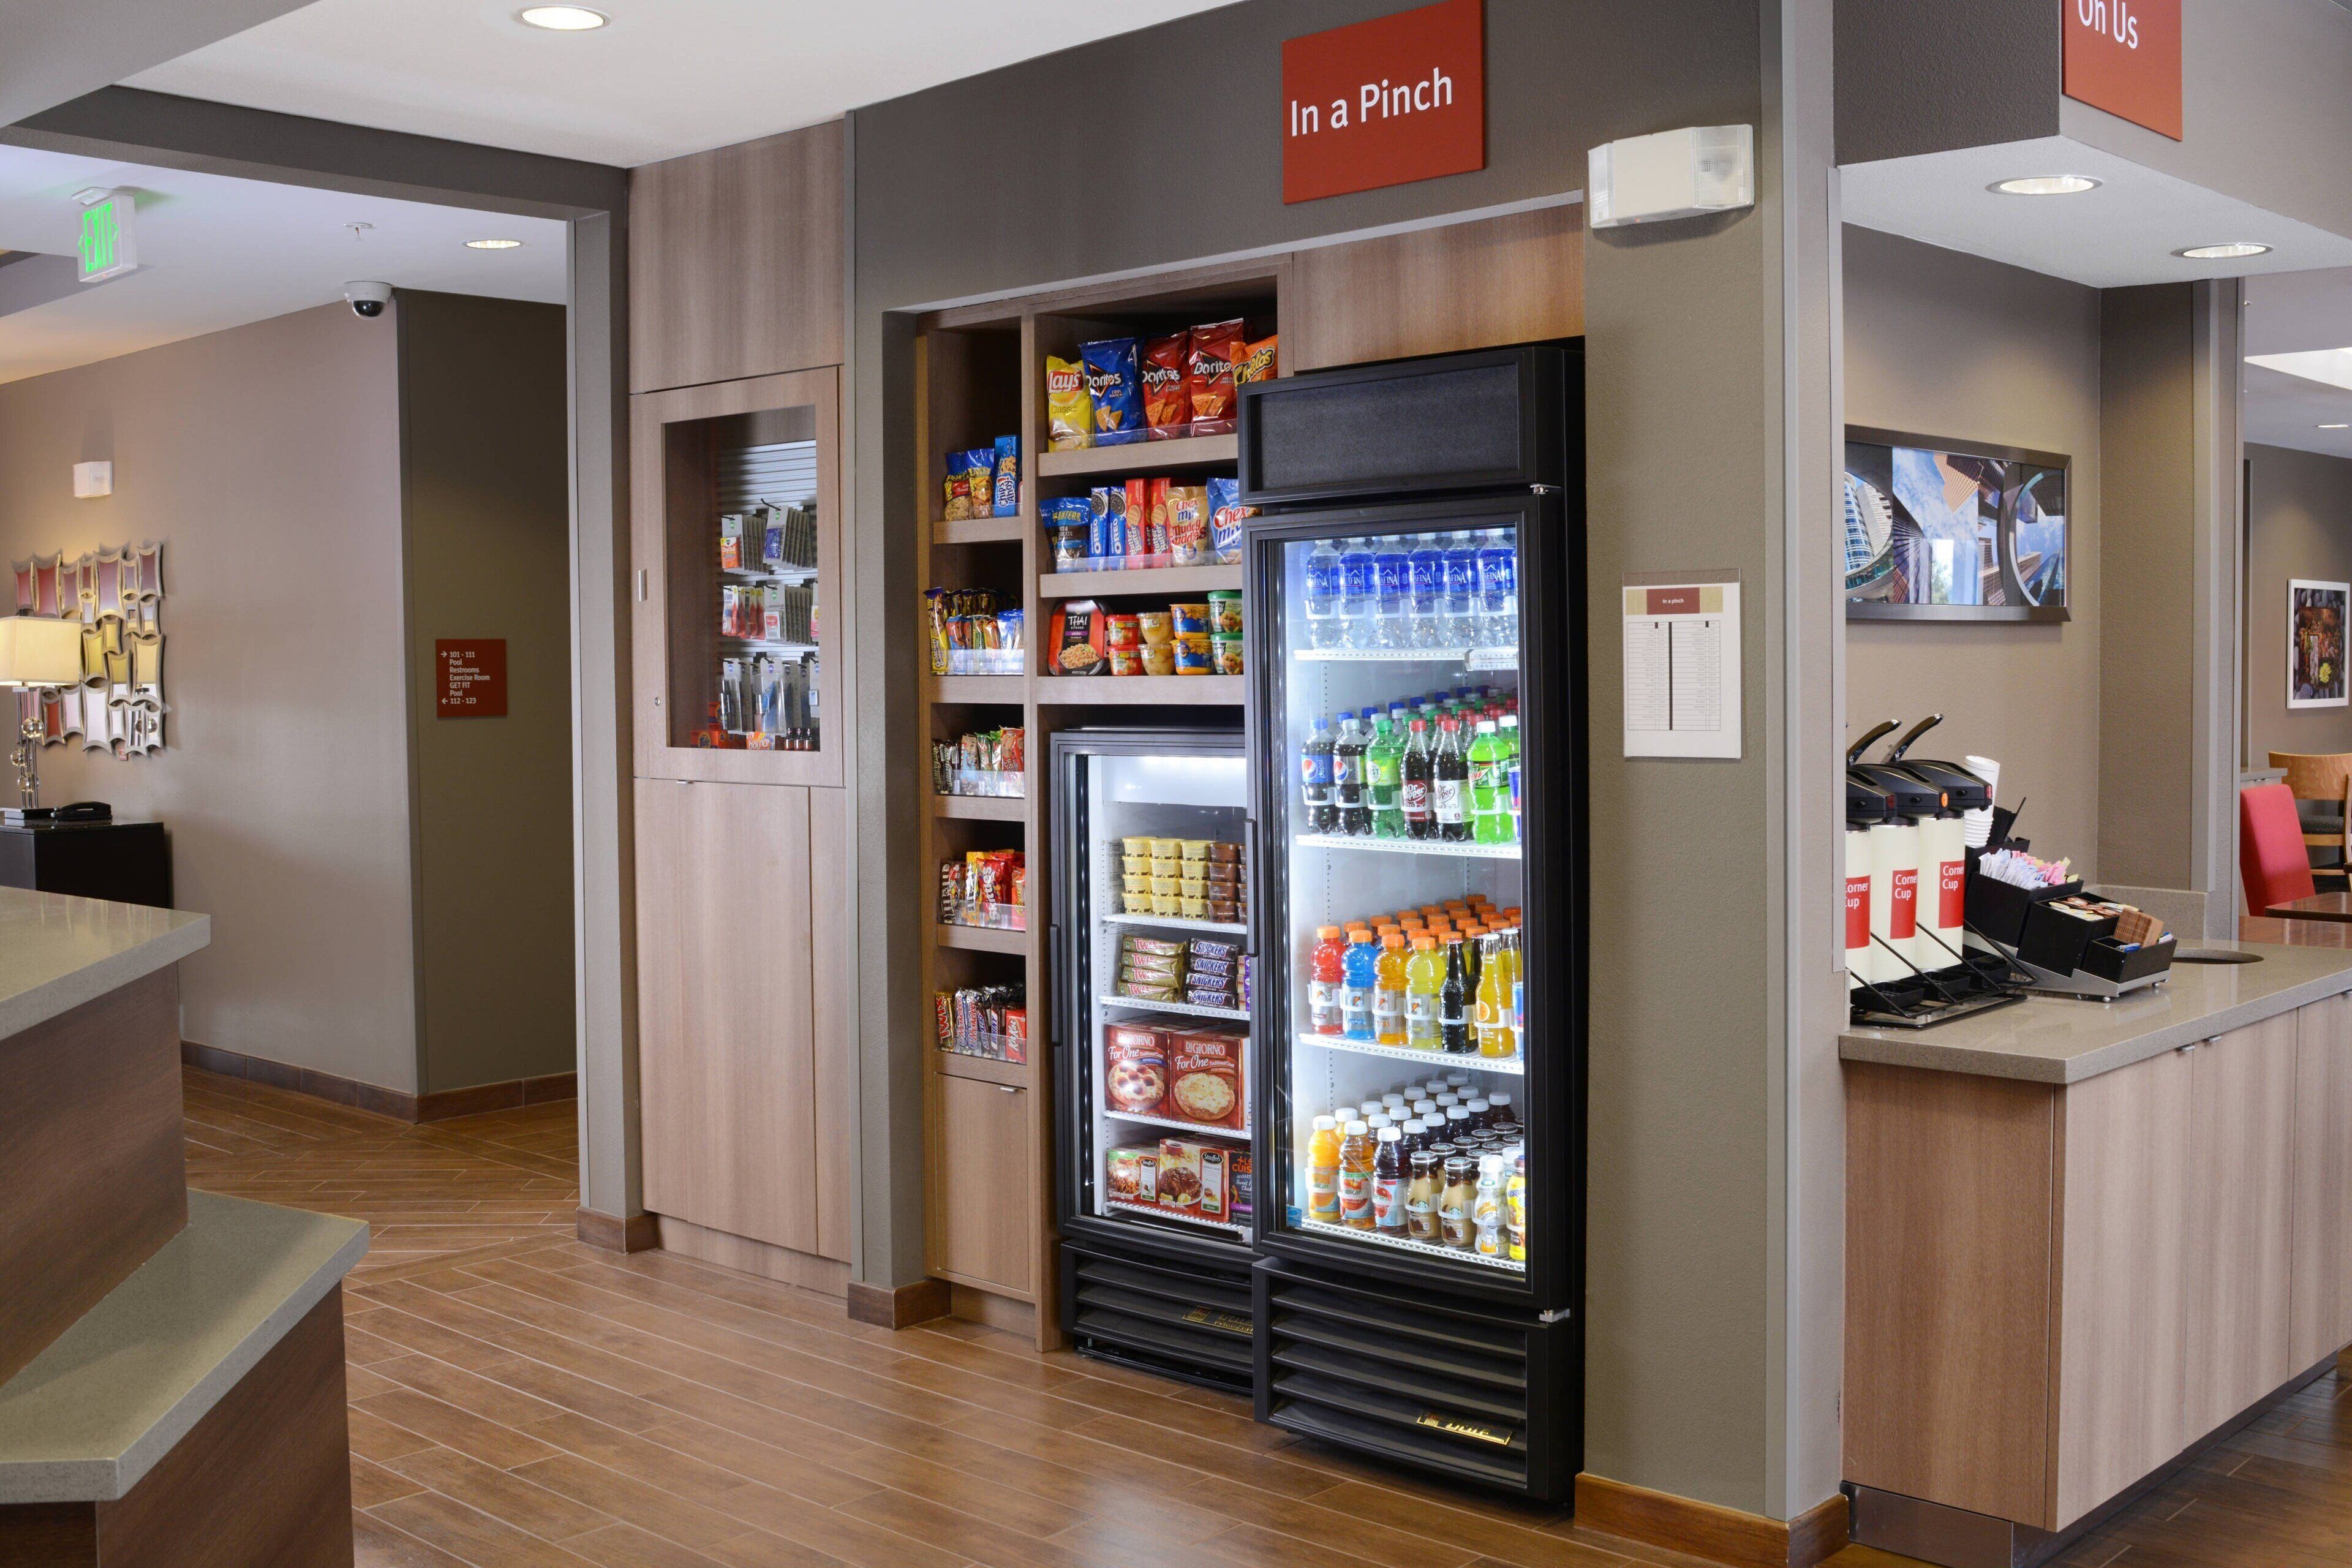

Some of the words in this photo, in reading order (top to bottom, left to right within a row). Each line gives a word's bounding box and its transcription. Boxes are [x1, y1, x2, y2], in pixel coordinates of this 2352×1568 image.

[2078, 0, 2106, 34] On
[2113, 0, 2138, 49] Us
[1292, 100, 1318, 137] In
[1330, 99, 1348, 129] a
[1360, 67, 1452, 123] Pinch
[83, 202, 113, 273] EXIT
[1194, 361, 1233, 375] Dorito
[1049, 371, 1081, 393] Lay's
[1086, 373, 1121, 387] Doritos
[1142, 368, 1181, 384] Doritos
[998, 483, 1008, 507] Chips
[1176, 498, 1199, 511] Chex
[1052, 511, 1081, 522] PANTERS
[1214, 506, 1248, 529] Chex
[1172, 519, 1201, 535] Muddy
[1114, 518, 1122, 554] OREO
[1068, 616, 1088, 626] THAI
[1405, 788, 1425, 800] epper
[1408, 784, 1418, 793] Dr
[1438, 789, 1453, 801] pper
[1943, 865, 1964, 876] Corner
[1942, 879, 1958, 891] Cup
[1894, 888, 1911, 901] Cup
[1196, 942, 1227, 956] SNICKERS
[1196, 959, 1227, 973] SNICKERS
[1192, 975, 1226, 988] SNICKERS
[1192, 990, 1225, 1004] SNICKERS
[1108, 1046, 1121, 1060] For
[1122, 1044, 1139, 1058] One
[1186, 1041, 1225, 1056] DIGIORNO
[1175, 1055, 1189, 1071] For
[1190, 1054, 1208, 1069] One
[1204, 1152, 1221, 1163] Stouffer's
